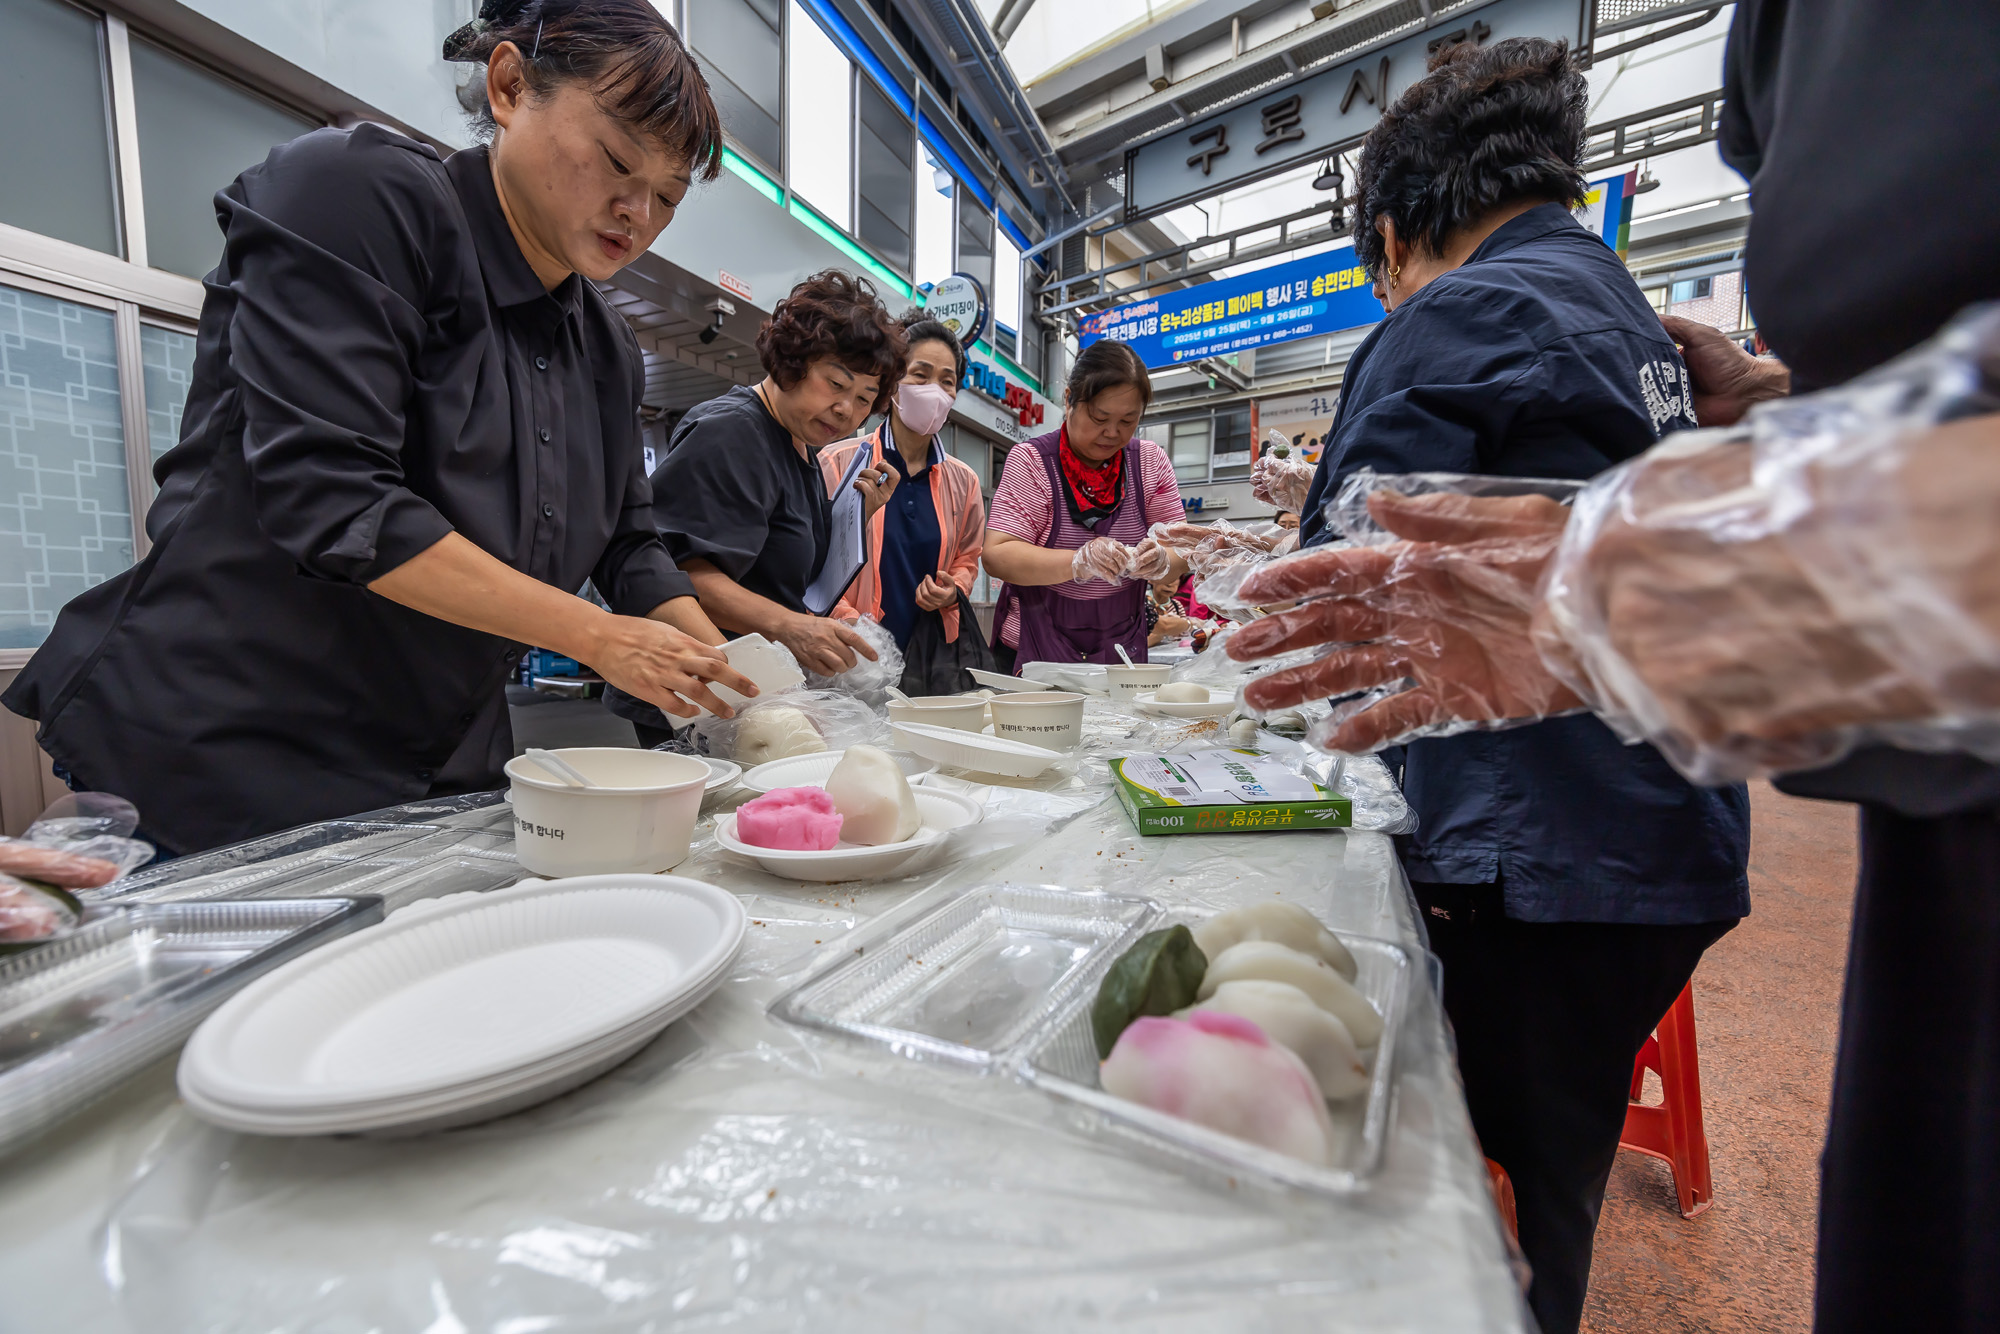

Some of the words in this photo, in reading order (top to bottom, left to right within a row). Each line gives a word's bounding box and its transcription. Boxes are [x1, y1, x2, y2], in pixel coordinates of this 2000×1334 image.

[721, 272, 740, 289] CCTV
[1160, 300, 1225, 333] 온누리상품권
[1227, 290, 1264, 316] 페이백
[1266, 283, 1293, 307] 행사
[1295, 279, 1309, 301] 및
[1311, 264, 1372, 297] 송편만들
[1174, 331, 1201, 344] 2025년
[1203, 327, 1216, 338] 9월
[1260, 314, 1275, 325] 9월
[1056, 724, 1070, 732] 합니다
[521, 819, 534, 834] 함께
[536, 825, 565, 840] 합니다
